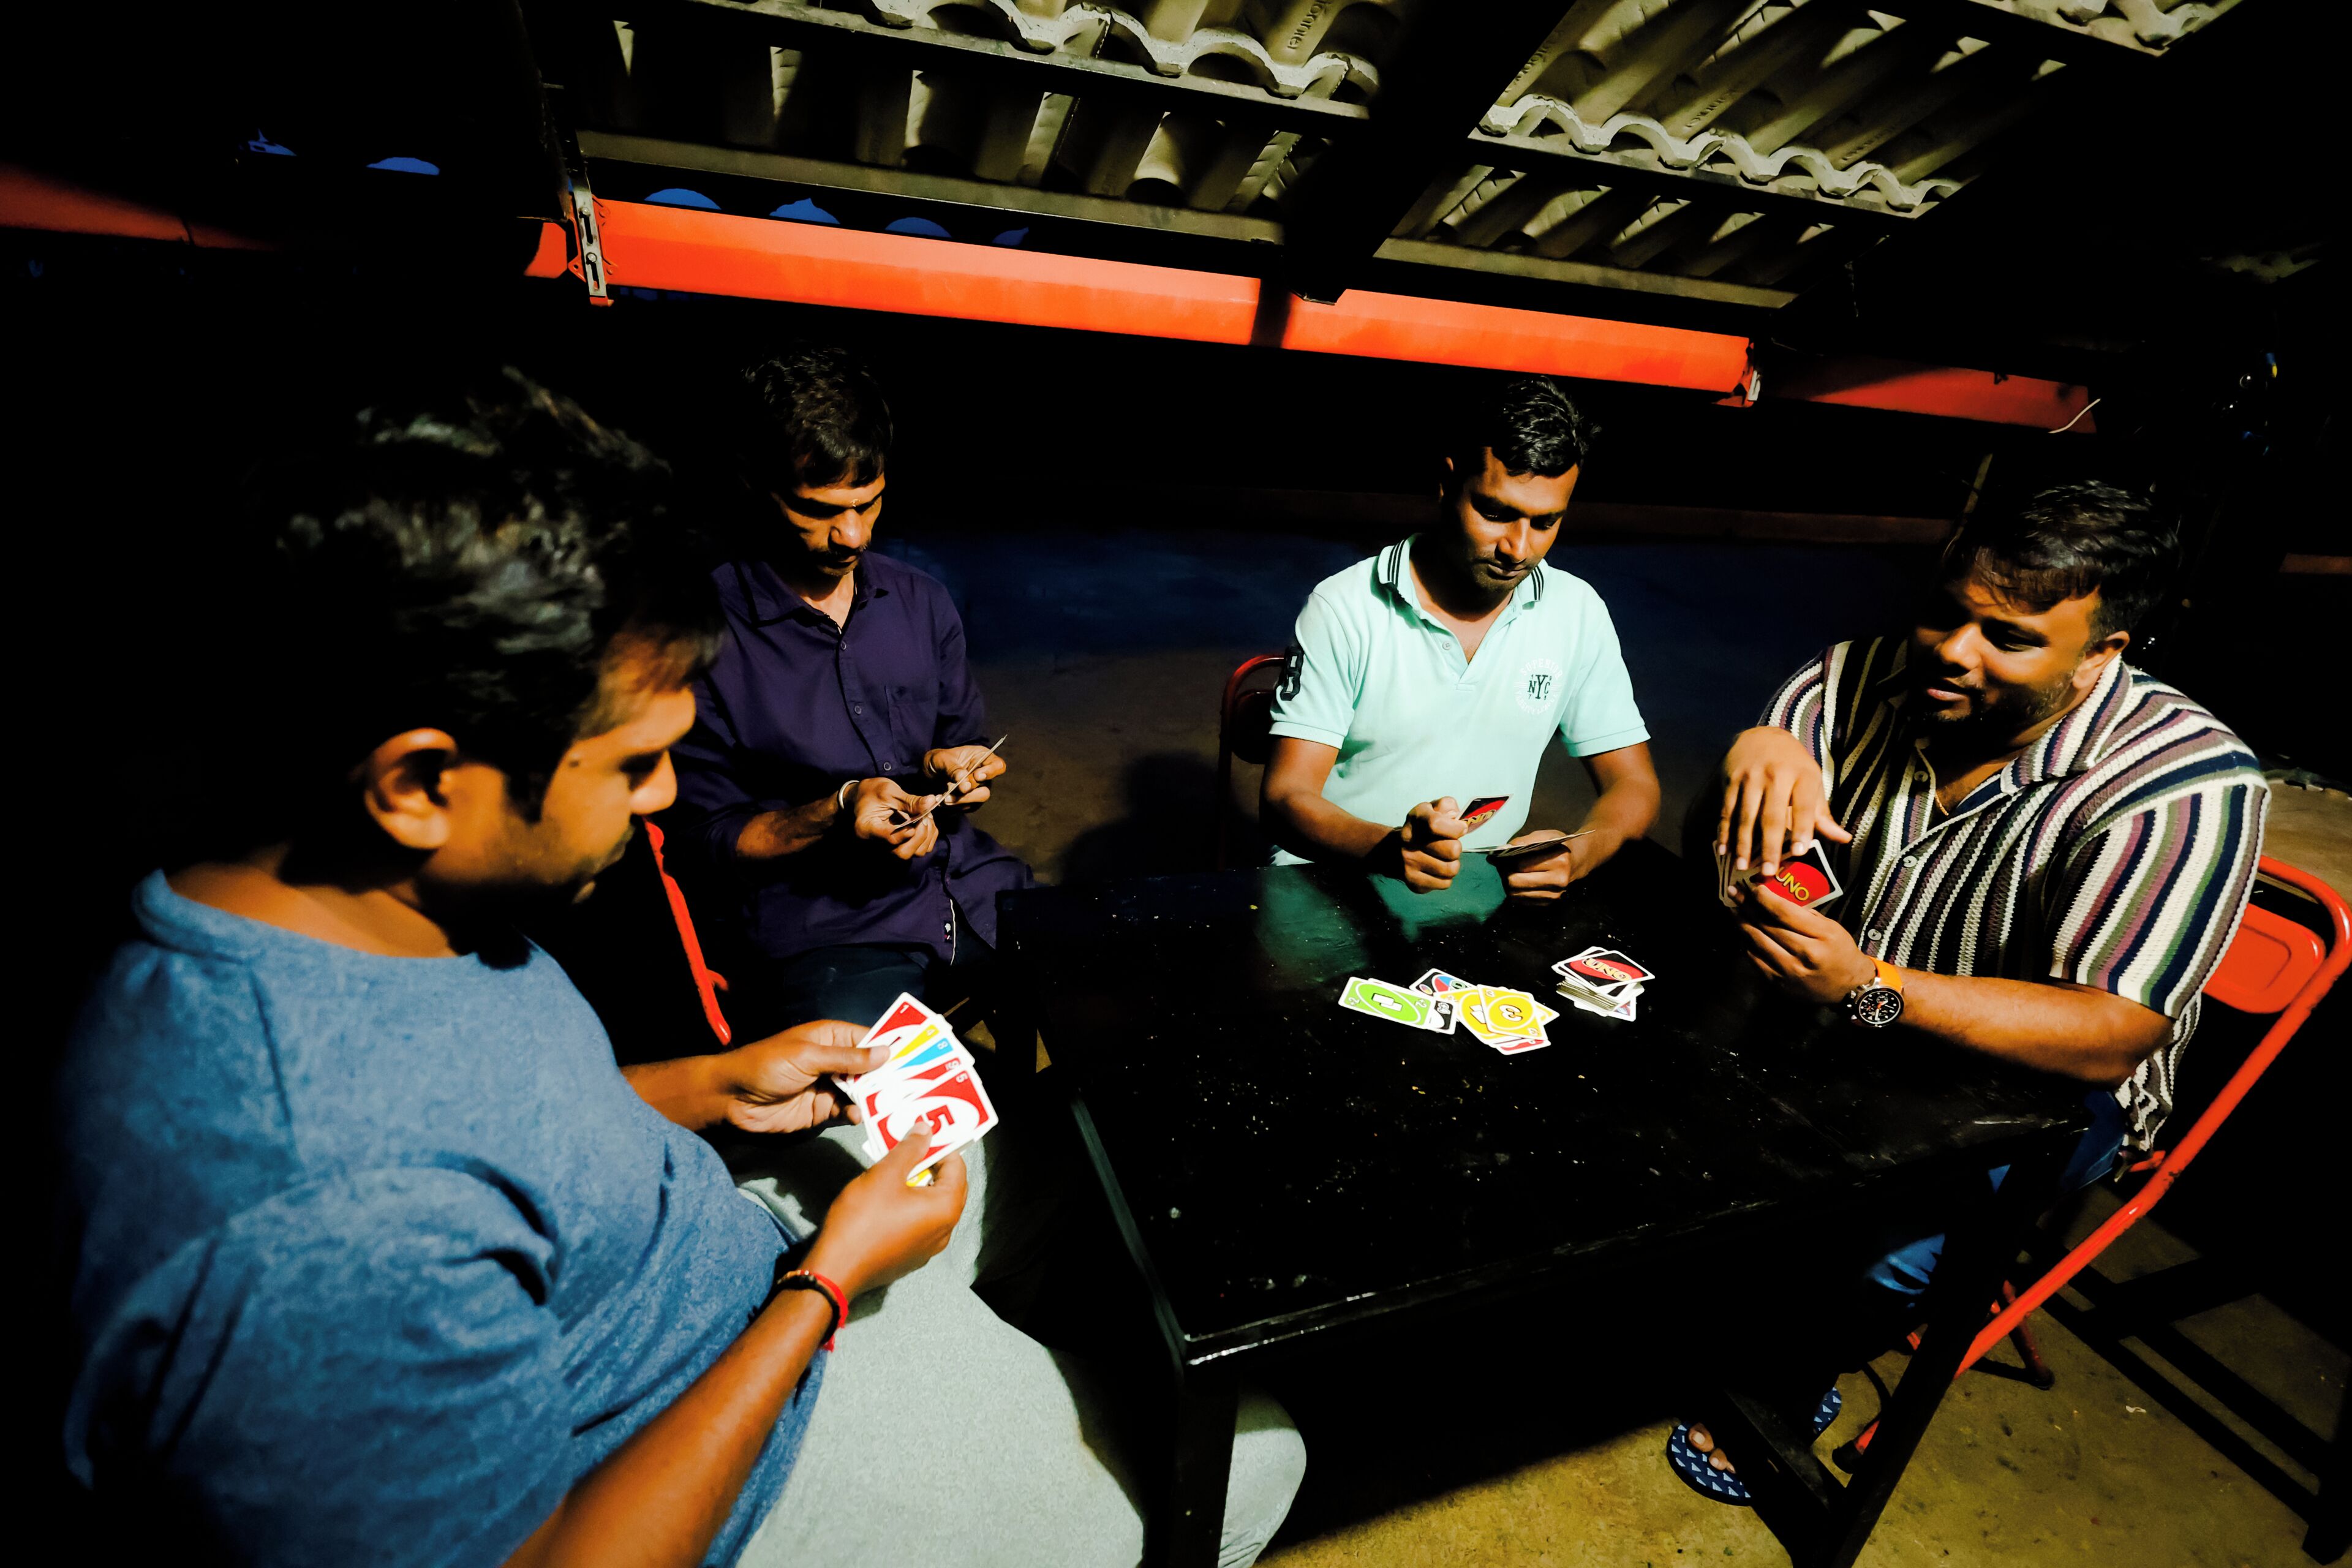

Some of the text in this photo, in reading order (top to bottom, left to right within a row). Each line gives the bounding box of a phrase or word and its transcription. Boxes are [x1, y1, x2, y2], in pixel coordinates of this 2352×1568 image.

[1527, 674, 1550, 699] NYC
[1776, 867, 1809, 901] UNO
[1581, 957, 1632, 982] UNO
[900, 1005, 910, 1014] 1
[1498, 1004, 1523, 1022] 3
[937, 1041, 949, 1050] 8
[956, 1072, 968, 1084] 5
[915, 1104, 955, 1136] 5
